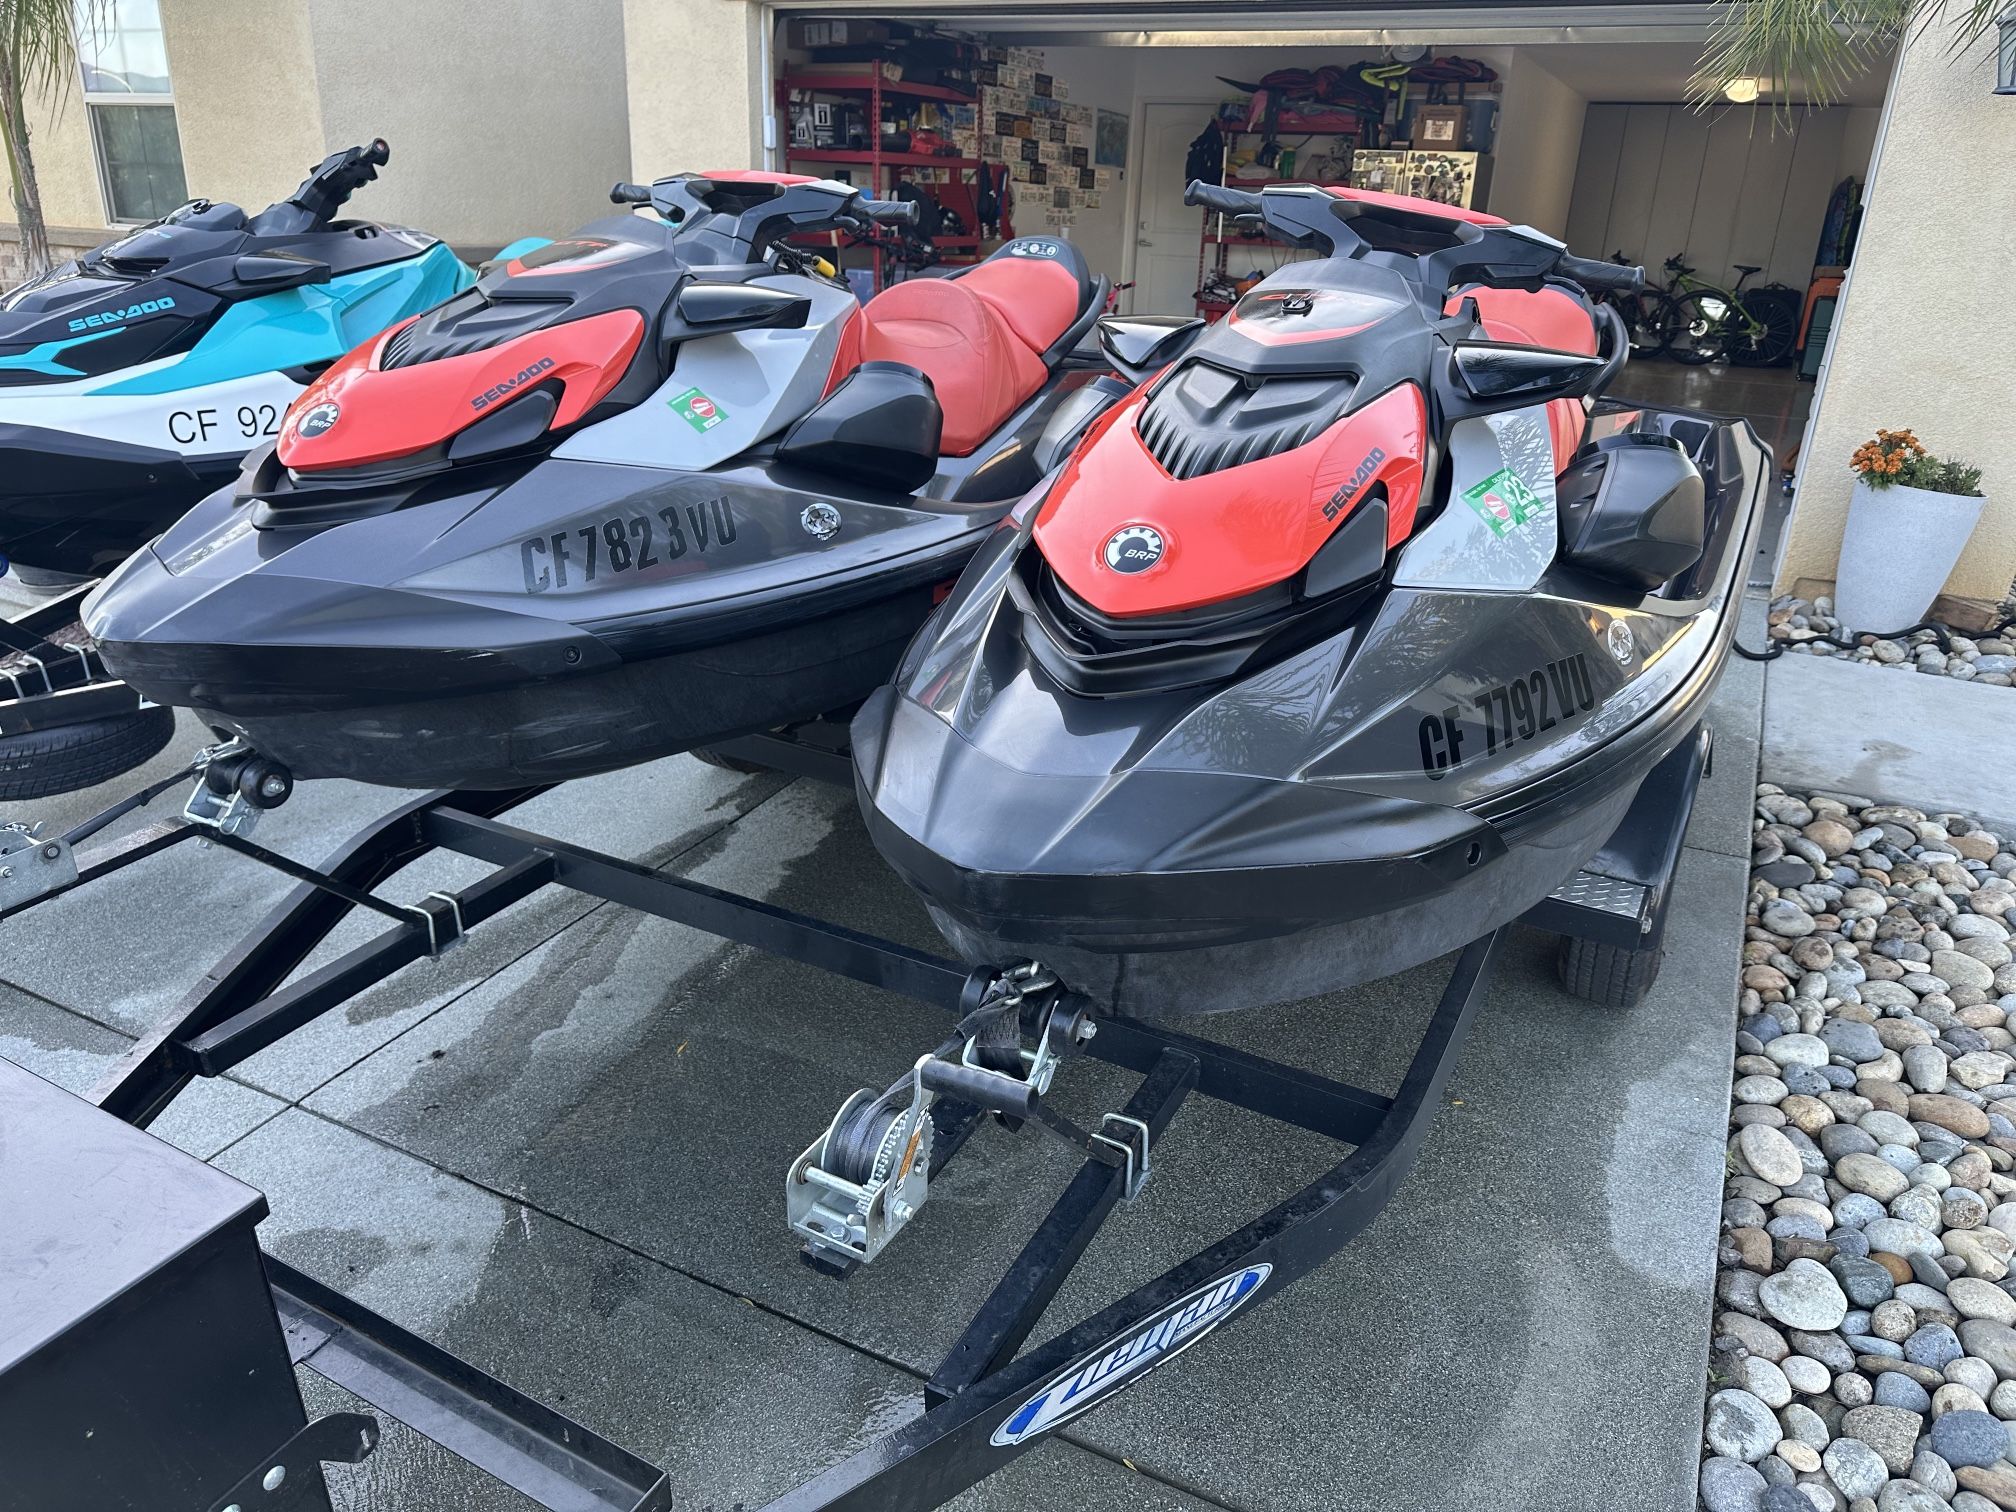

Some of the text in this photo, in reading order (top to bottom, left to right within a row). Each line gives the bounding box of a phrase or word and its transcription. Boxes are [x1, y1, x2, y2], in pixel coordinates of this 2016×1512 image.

[168, 403, 292, 444] CF 92
[310, 419, 332, 429] BRP
[1503, 475, 1535, 507] 23
[520, 530, 570, 595] CF
[1124, 549, 1158, 561] BRP
[1418, 704, 1465, 782] CF
